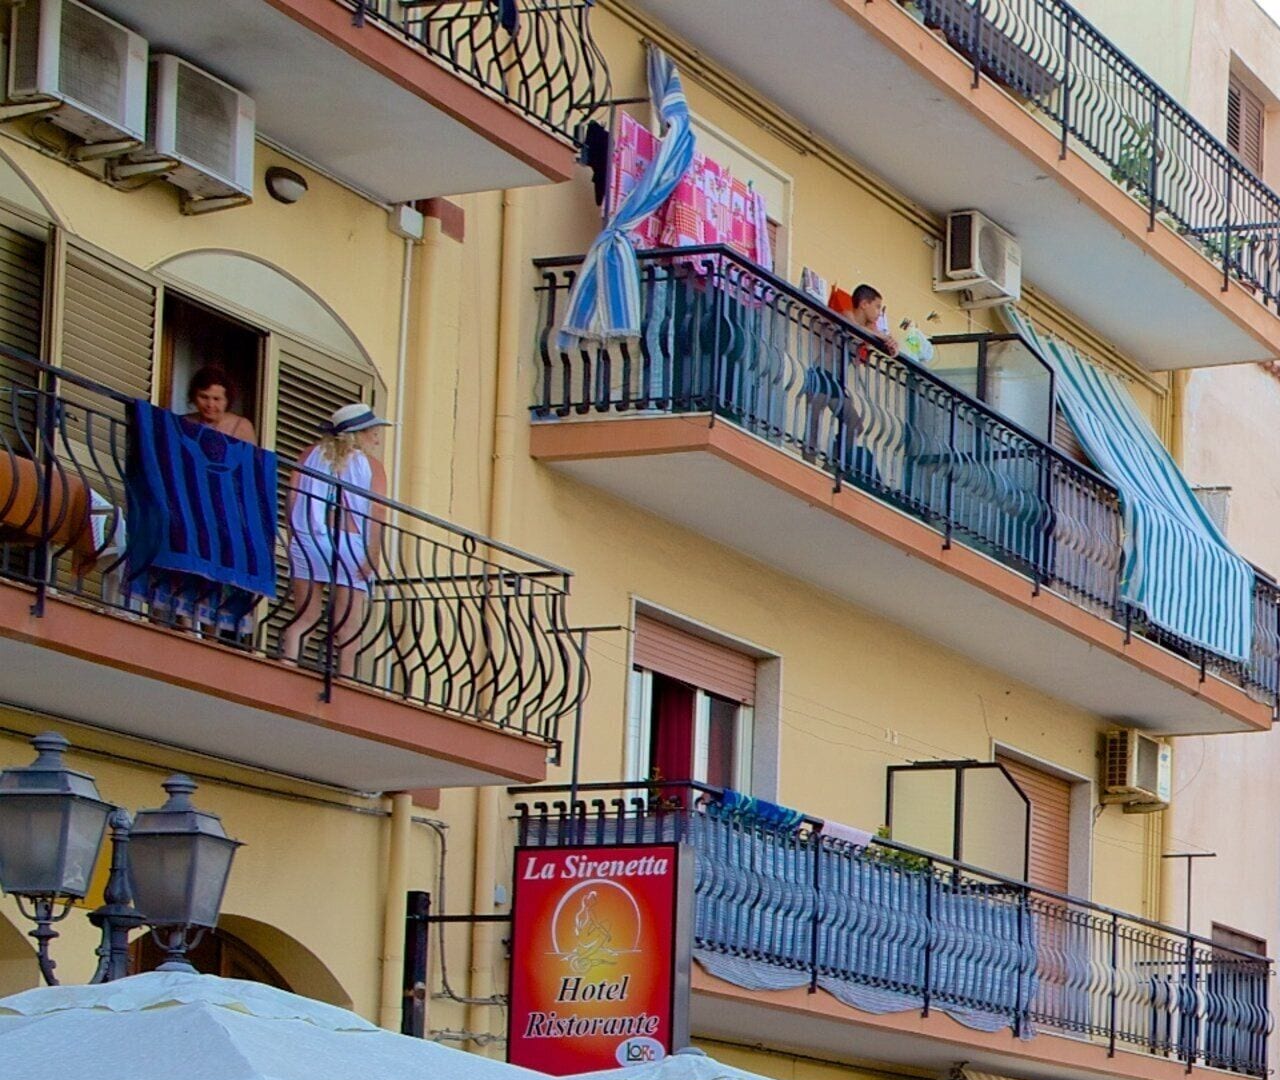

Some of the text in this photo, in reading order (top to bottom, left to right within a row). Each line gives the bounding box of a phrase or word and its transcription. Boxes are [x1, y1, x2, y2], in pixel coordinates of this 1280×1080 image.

[523, 855, 669, 880] La Sirenetta
[555, 975, 631, 1003] Hotel
[523, 1012, 661, 1038] Ristorante
